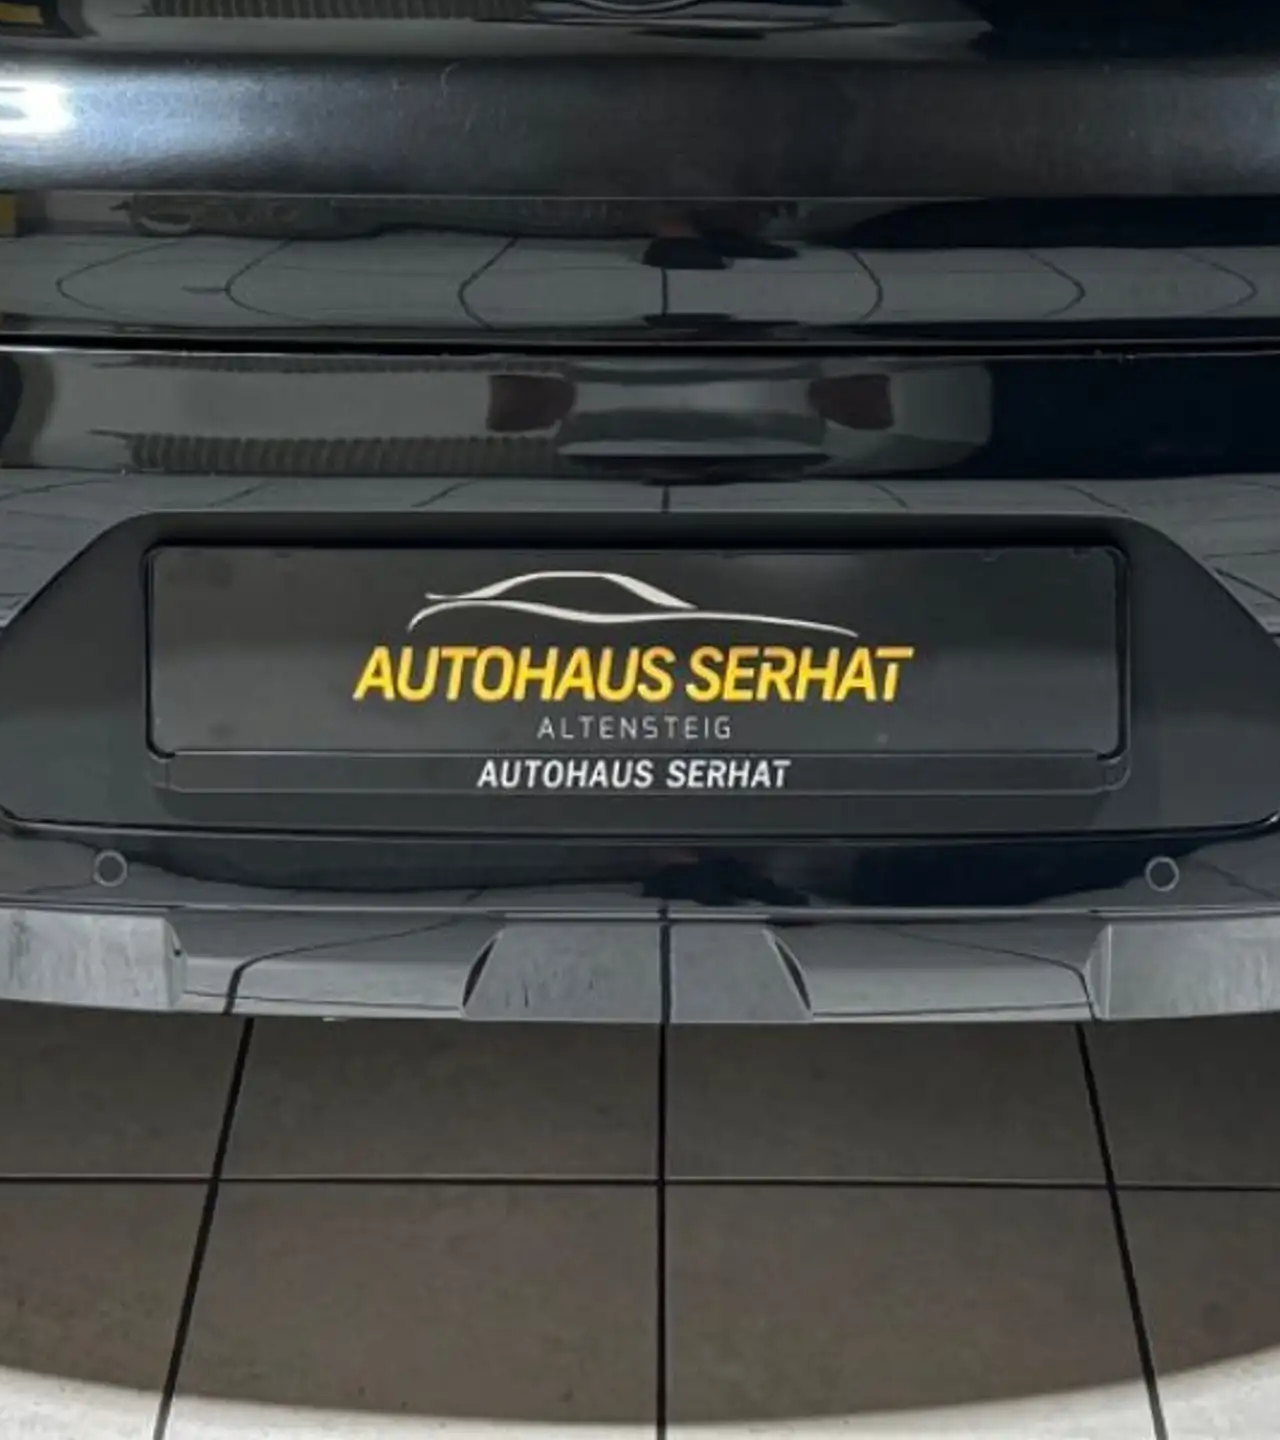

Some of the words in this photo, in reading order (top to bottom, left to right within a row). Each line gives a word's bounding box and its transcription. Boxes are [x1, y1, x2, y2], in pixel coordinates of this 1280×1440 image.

[352, 645, 676, 703] AUTOHAUS
[685, 646, 914, 702] SERHAT
[536, 714, 732, 741] ALTENSTEIG
[476, 759, 654, 789] AUTOHAUS
[666, 759, 792, 789] SERHAT
